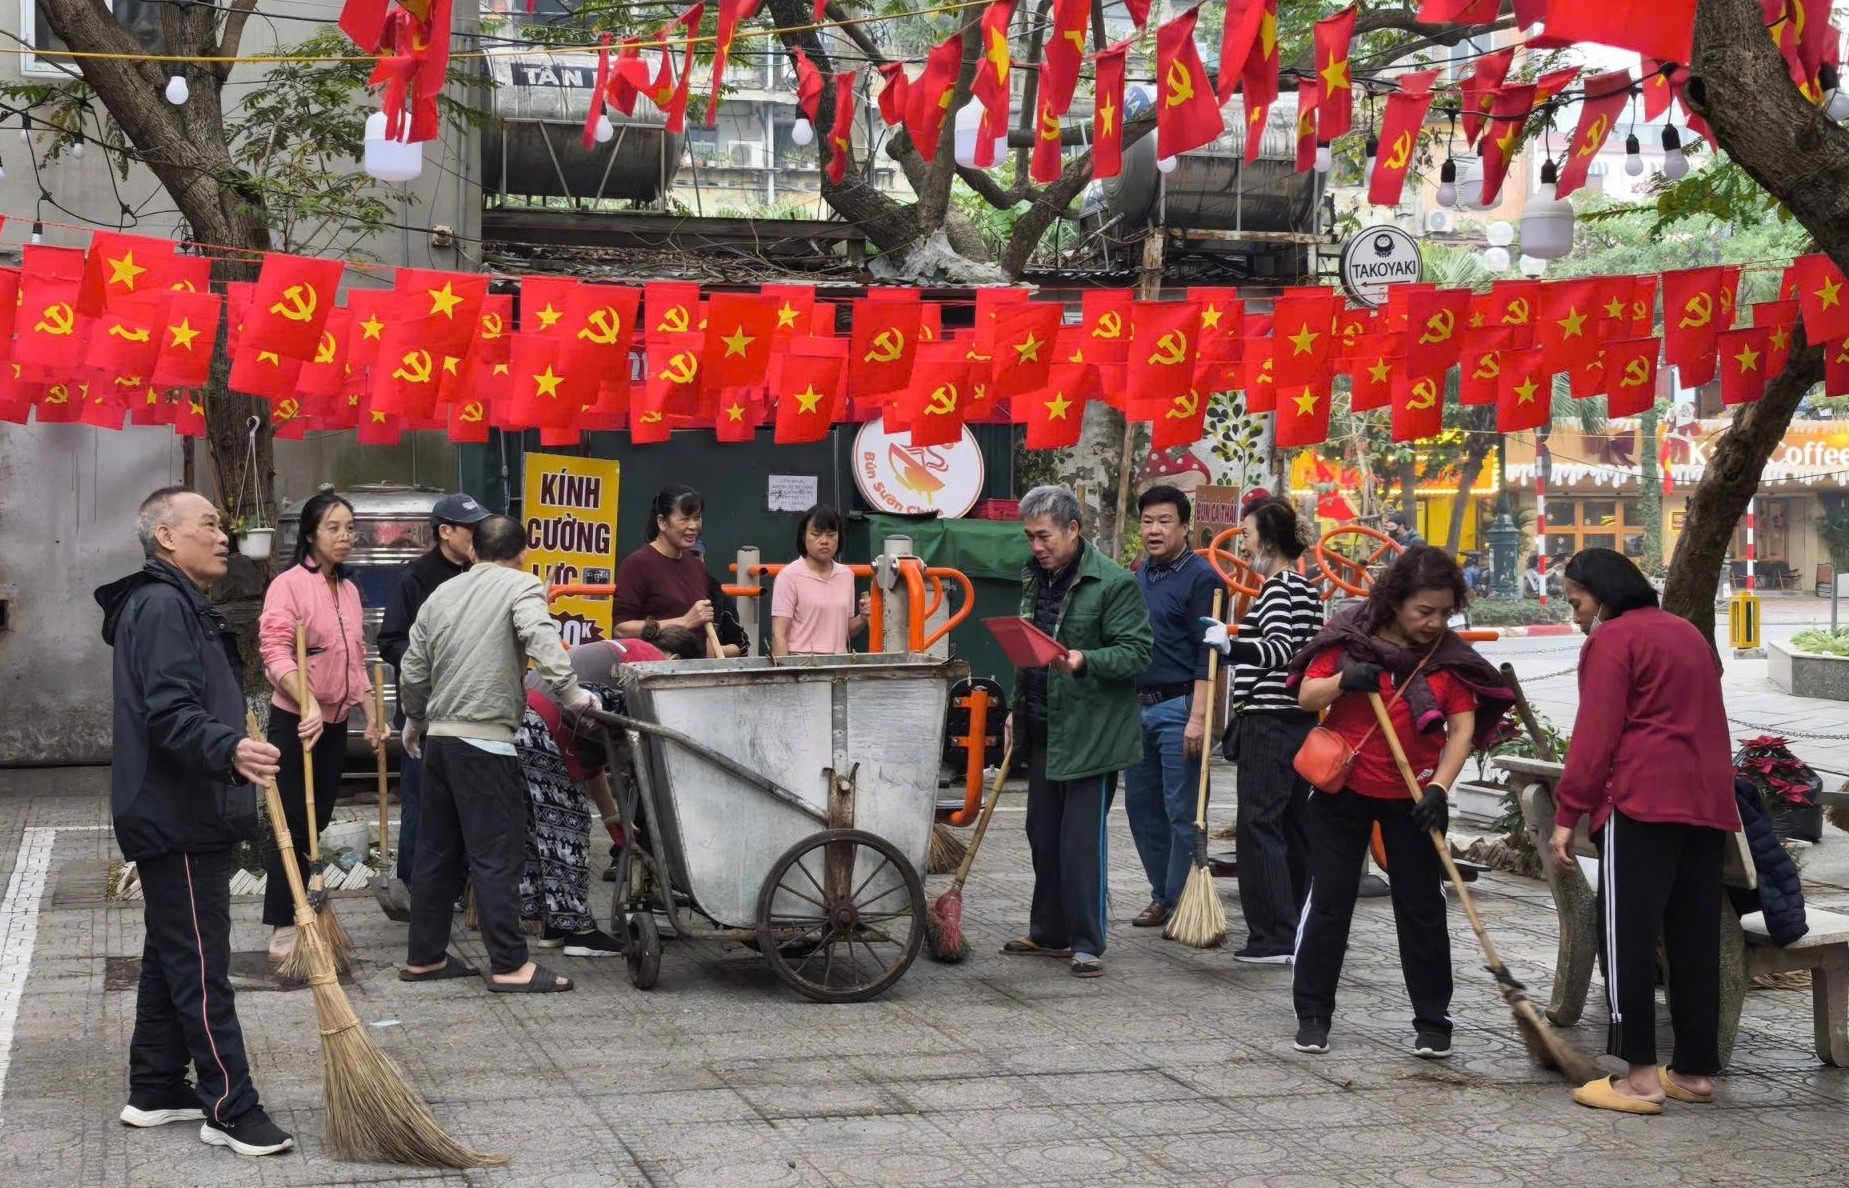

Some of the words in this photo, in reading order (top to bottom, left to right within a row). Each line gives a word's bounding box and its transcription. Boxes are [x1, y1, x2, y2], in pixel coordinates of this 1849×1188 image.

[1352, 260, 1416, 279] TAKOYAKI
[864, 451, 877, 479] Bún
[540, 468, 601, 509] KÍNH
[527, 513, 611, 555] CƯỜNG
